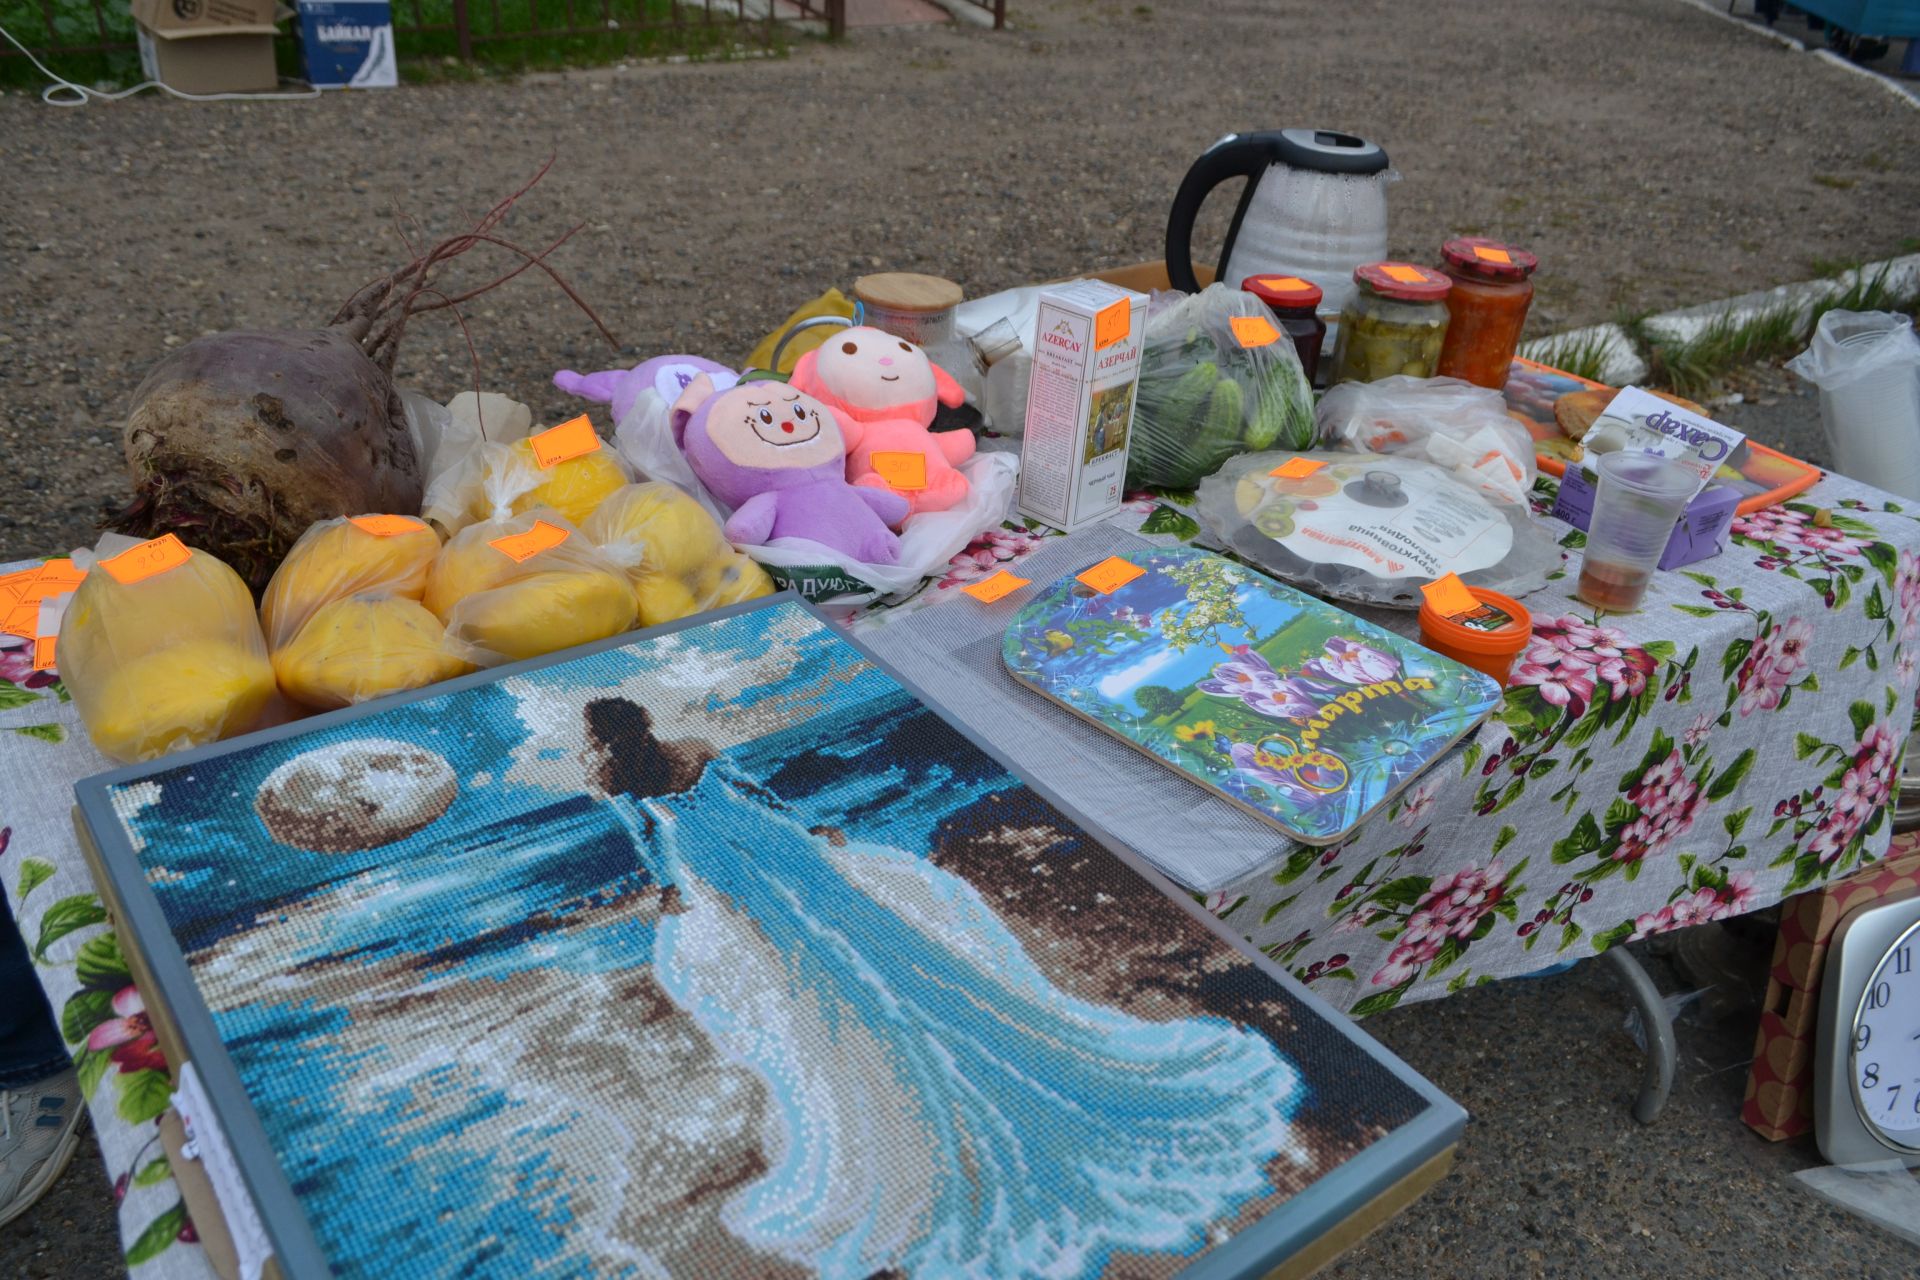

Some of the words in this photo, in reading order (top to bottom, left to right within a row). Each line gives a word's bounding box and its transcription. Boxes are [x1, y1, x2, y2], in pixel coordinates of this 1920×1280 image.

[316, 23, 371, 42] БАЙКАЛ
[1042, 332, 1083, 353] AZERÇAY
[1097, 346, 1137, 370] АЗЕРЧАЙ
[1645, 410, 1729, 462] Сахар
[1348, 524, 1437, 576] Фруктовница
[1895, 946, 1911, 975] 11
[1867, 981, 1891, 1010] 10
[1856, 1023, 1871, 1052] 9
[1861, 1062, 1880, 1090] 8
[1887, 1084, 1902, 1112] 7
